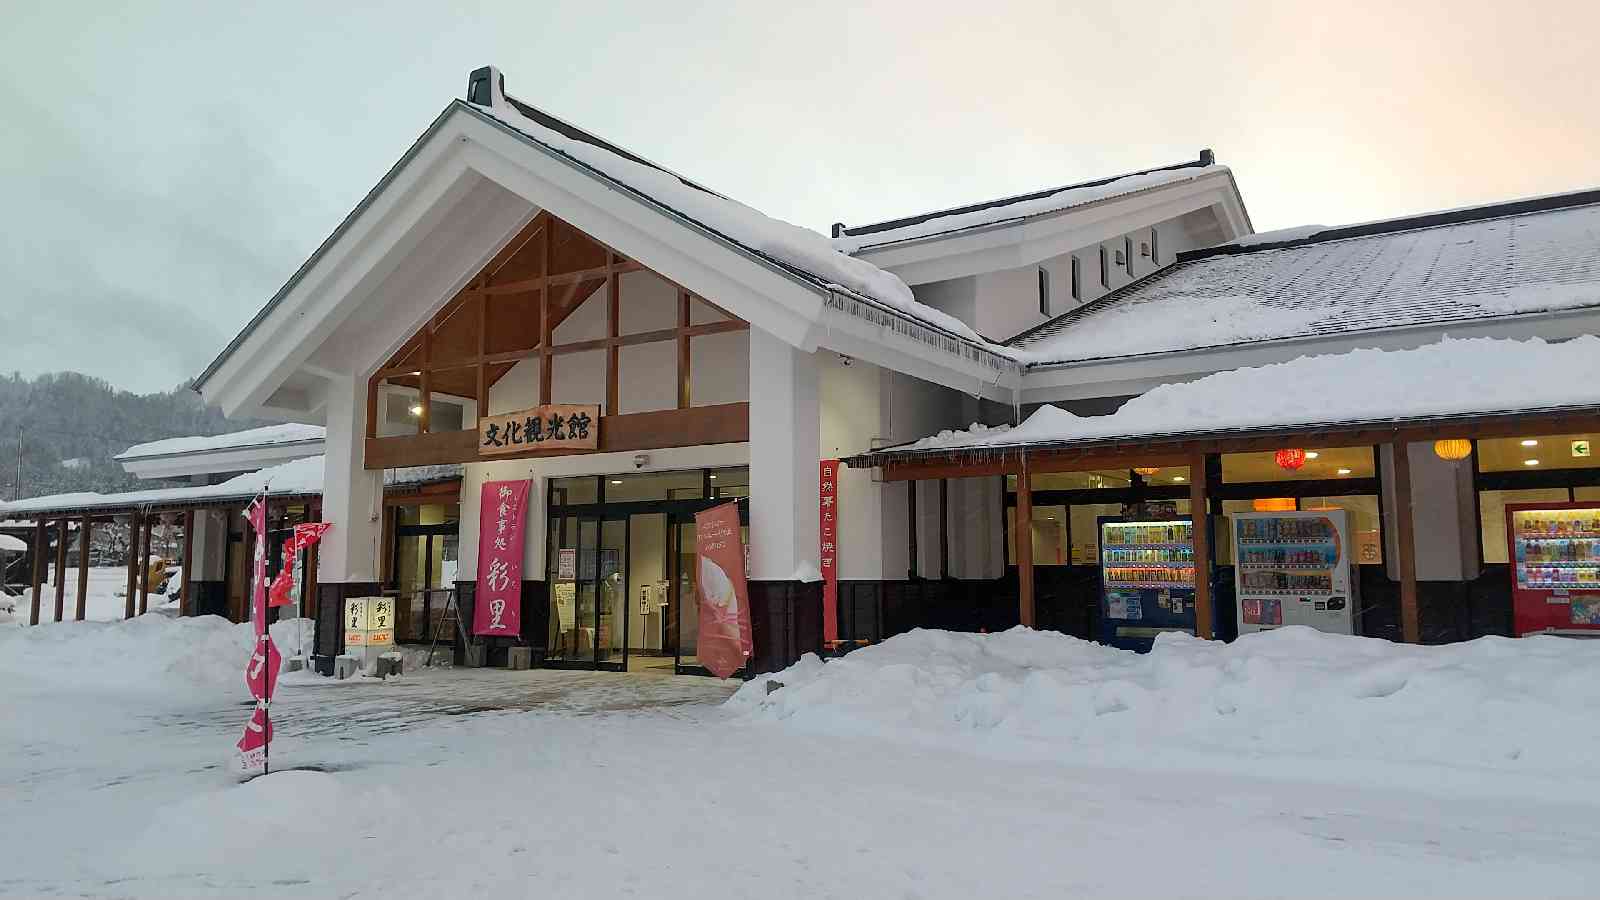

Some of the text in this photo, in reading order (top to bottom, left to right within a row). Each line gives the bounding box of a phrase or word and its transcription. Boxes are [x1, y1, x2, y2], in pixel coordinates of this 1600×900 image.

[486, 486, 513, 630] 御食事処 彩里
